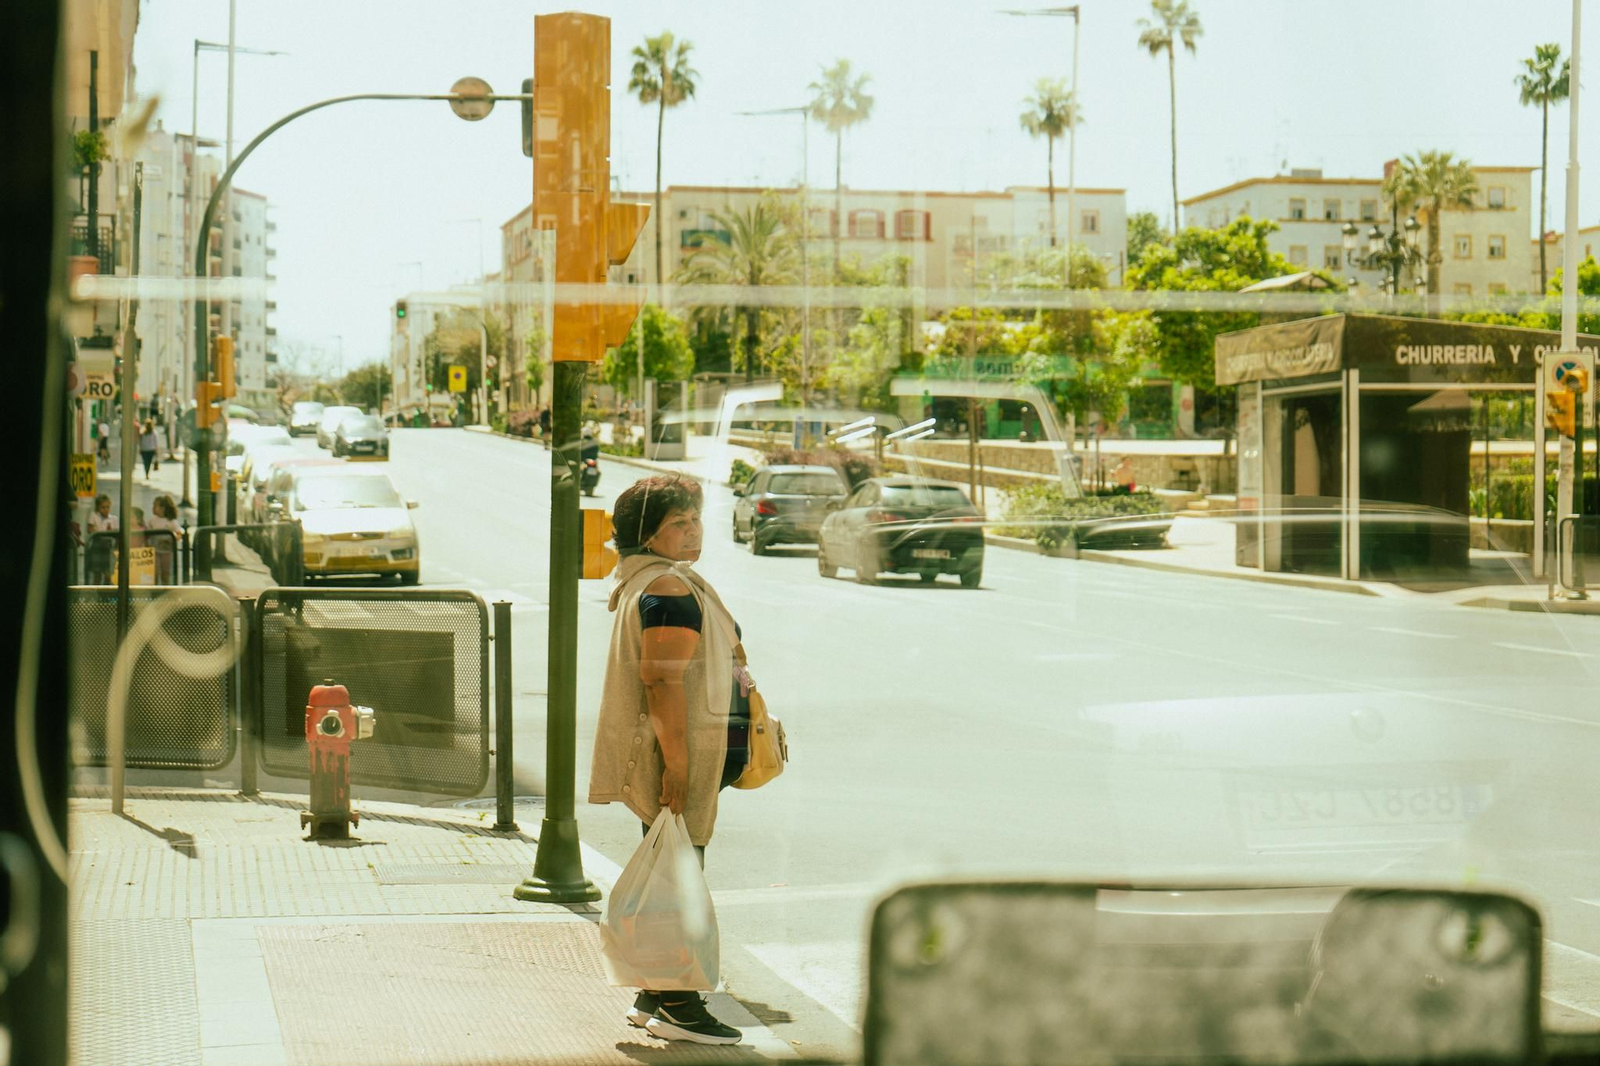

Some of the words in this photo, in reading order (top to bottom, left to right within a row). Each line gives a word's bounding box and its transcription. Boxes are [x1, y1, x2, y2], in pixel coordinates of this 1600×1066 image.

[1395, 344, 1496, 365] CHURRERIA
[1509, 344, 1522, 364] Y
[72, 467, 93, 491] ORO
